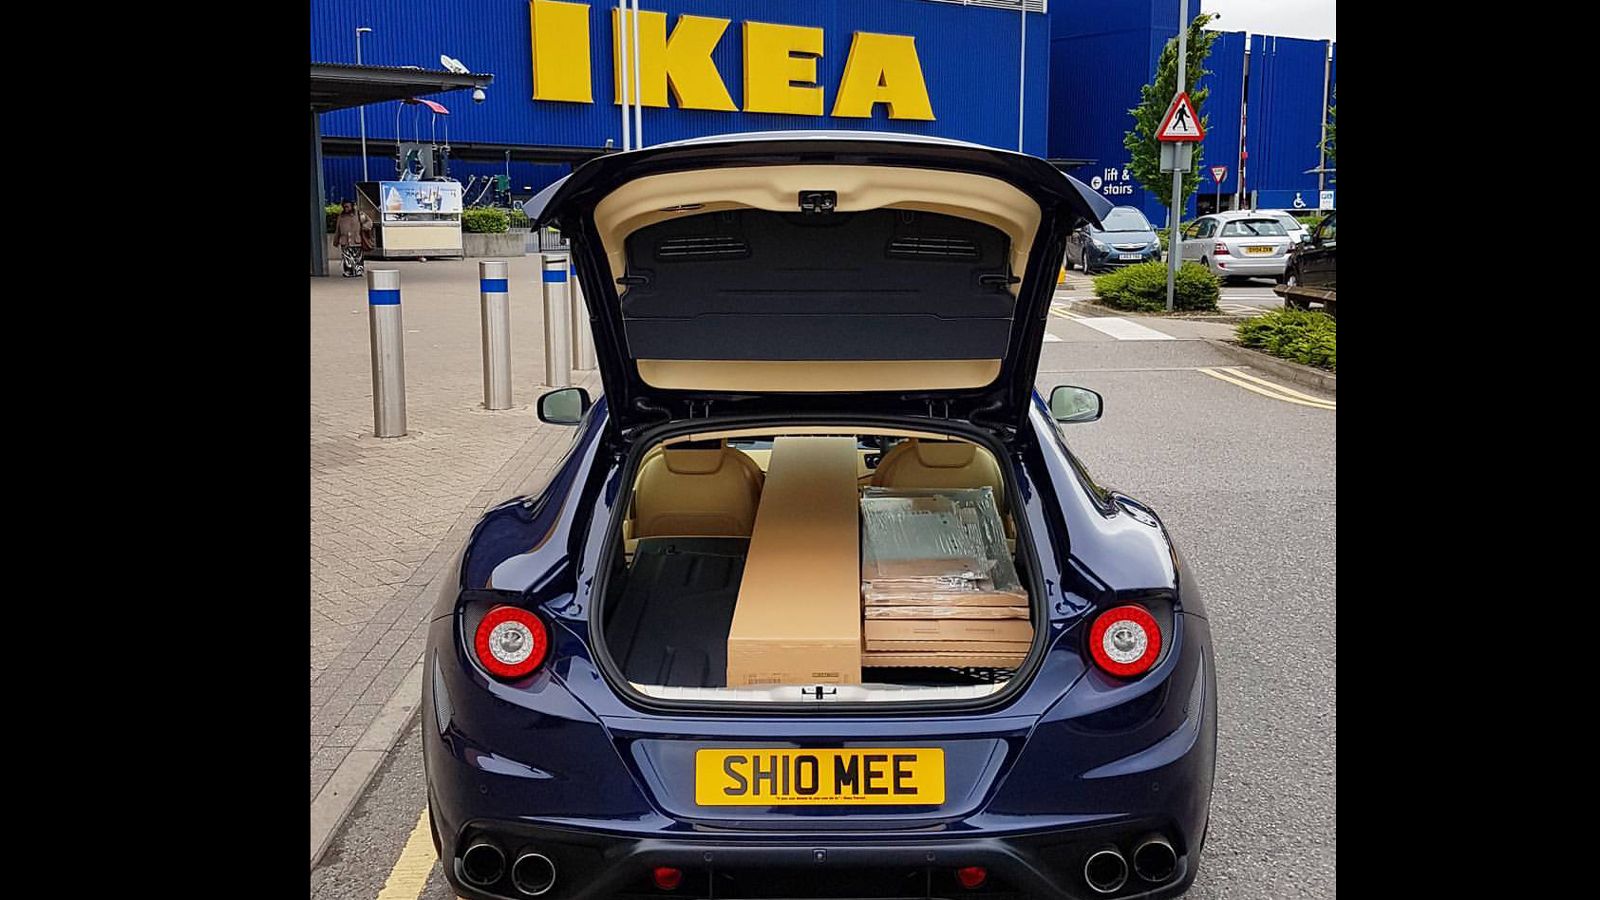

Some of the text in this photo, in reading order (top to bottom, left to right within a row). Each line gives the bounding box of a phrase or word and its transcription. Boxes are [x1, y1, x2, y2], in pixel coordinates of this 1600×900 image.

[530, 0, 936, 121] IKEA
[1104, 168, 1130, 181] lift &
[1103, 182, 1133, 195] stairs
[834, 754, 918, 795] MEE
